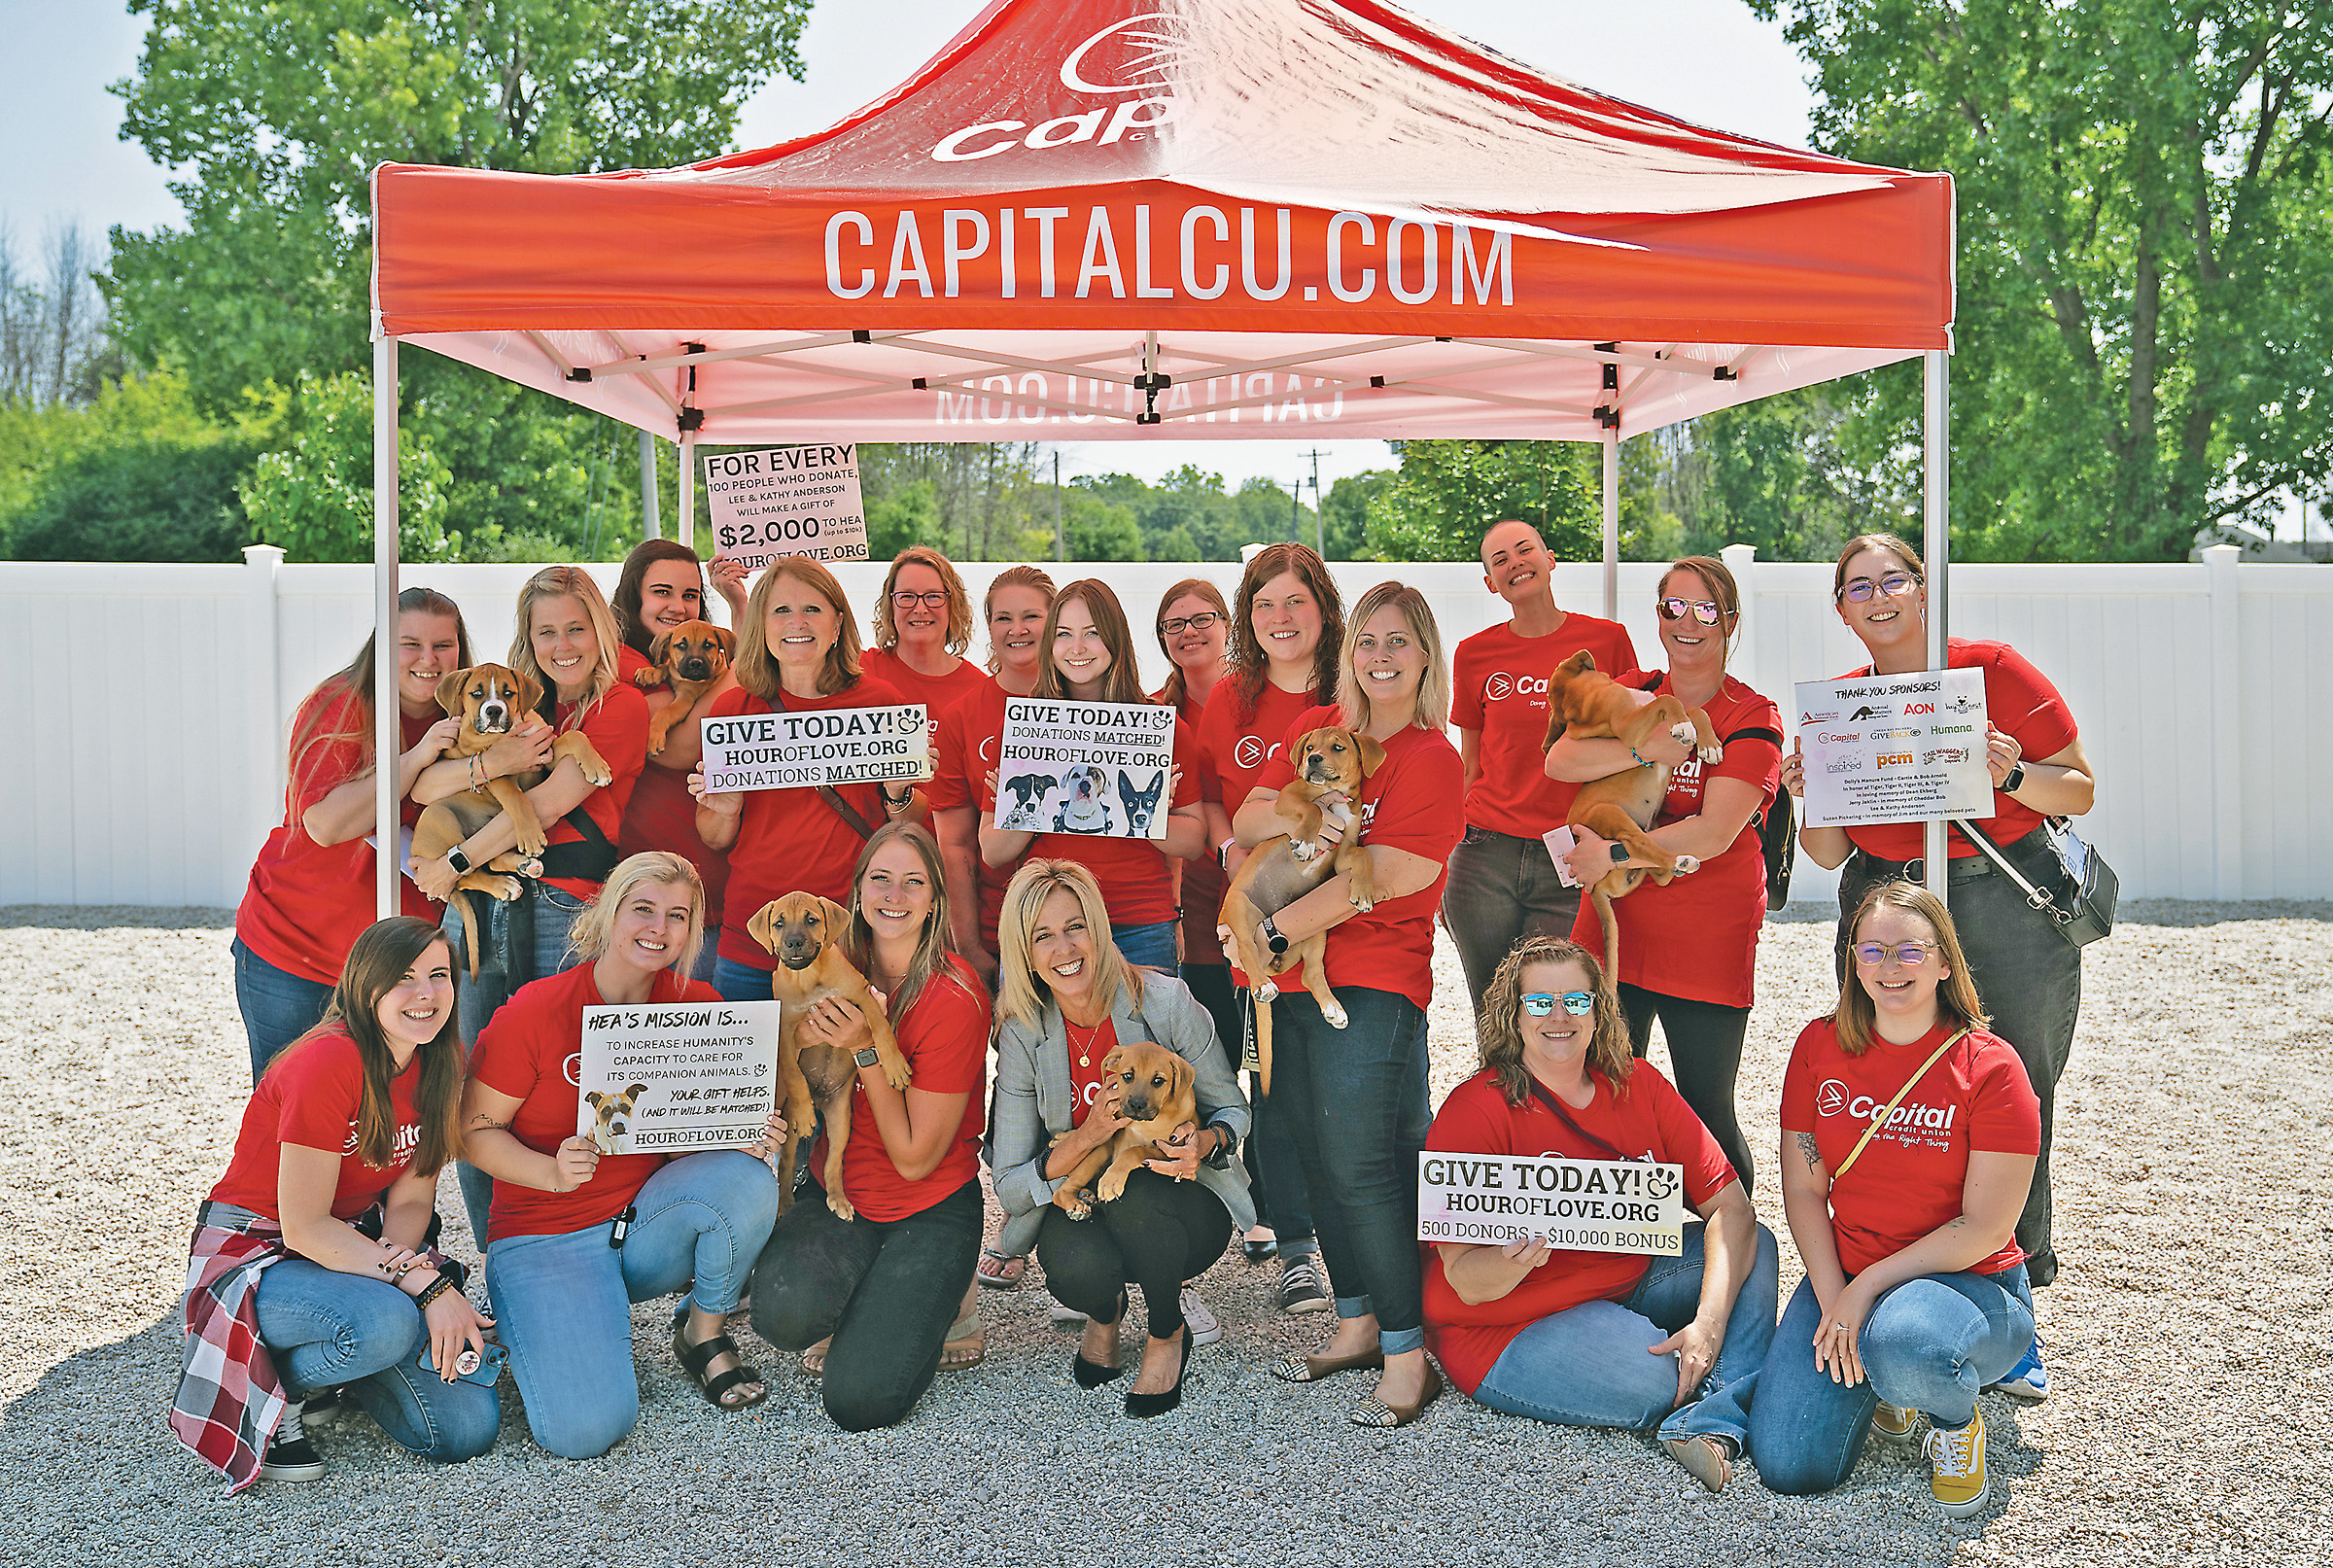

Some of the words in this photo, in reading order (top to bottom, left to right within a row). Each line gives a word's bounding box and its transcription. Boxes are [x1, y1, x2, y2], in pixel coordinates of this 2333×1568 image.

[824, 204, 1514, 306] CAPITALCU.COM
[709, 454, 760, 478] FOR
[770, 444, 853, 471] EVERY
[709, 482, 729, 493] 100
[732, 477, 774, 490] PEOPLE
[778, 474, 806, 485] WHO
[809, 470, 857, 482] DONATE,
[729, 495, 746, 504] LEE
[760, 491, 790, 501] KATHY
[793, 485, 846, 497] ANDERSON
[737, 508, 759, 517] WILL
[762, 505, 789, 513] MAKE
[800, 502, 820, 510] GIFT
[719, 517, 819, 549] $2,000
[822, 518, 837, 527] TO
[840, 516, 861, 525] HEA
[1835, 687, 1868, 699] THANK
[1868, 686, 1887, 697] YOU
[1889, 680, 1941, 695] SPONSORS!
[1008, 705, 1061, 723] GIVE
[1066, 708, 1148, 728] TODAY!
[1903, 703, 1934, 715] AON
[706, 719, 776, 746] GIVE
[783, 712, 893, 740] TODAY!
[1011, 726, 1091, 741] DONATIONS
[1094, 731, 1166, 746] MATCHED!
[1830, 733, 1860, 742] Capital
[725, 739, 908, 766] HOUROFLOVE.ORG
[1003, 745, 1170, 767] HOUROFLOVE.ORG
[1877, 754, 1913, 769] pcm
[713, 767, 821, 788] DONATIONS
[826, 760, 923, 782] MATCHED!
[1826, 761, 1862, 771] inspired
[588, 1011, 641, 1031] HEA'S
[644, 1009, 712, 1028] MISSION
[717, 1010, 749, 1027] IS...
[607, 1041, 622, 1051] TO
[624, 1039, 680, 1050] INCREASE
[683, 1036, 754, 1048] HUMANITY'S
[613, 1055, 671, 1065] CAPACITY
[673, 1054, 687, 1063] TO
[689, 1053, 718, 1063] CARE
[721, 1052, 744, 1062] FOR
[607, 1071, 625, 1082] ITS
[628, 1069, 697, 1080] COMPANION
[699, 1067, 751, 1078] ANIMALS.
[670, 1088, 702, 1102] YOUR
[703, 1088, 731, 1100] GIFT
[732, 1086, 771, 1098] HELPS.
[642, 1107, 668, 1119] (AND
[669, 1107, 680, 1117] IT
[680, 1105, 703, 1117] WILL
[704, 1105, 720, 1115] BE
[720, 1102, 771, 1115] MATCHED!)
[1898, 1133, 1922, 1148] Right
[1925, 1138, 1950, 1152] Thing
[1423, 1159, 1502, 1189] GIVE
[1512, 1164, 1641, 1196] TODAY!
[1445, 1193, 1659, 1222] HOUROFLOVE.ORG
[1421, 1221, 1451, 1237] 500
[1455, 1223, 1529, 1241] DONORS
[1548, 1227, 1610, 1246] $10,000
[1615, 1231, 1679, 1250] BONUS
